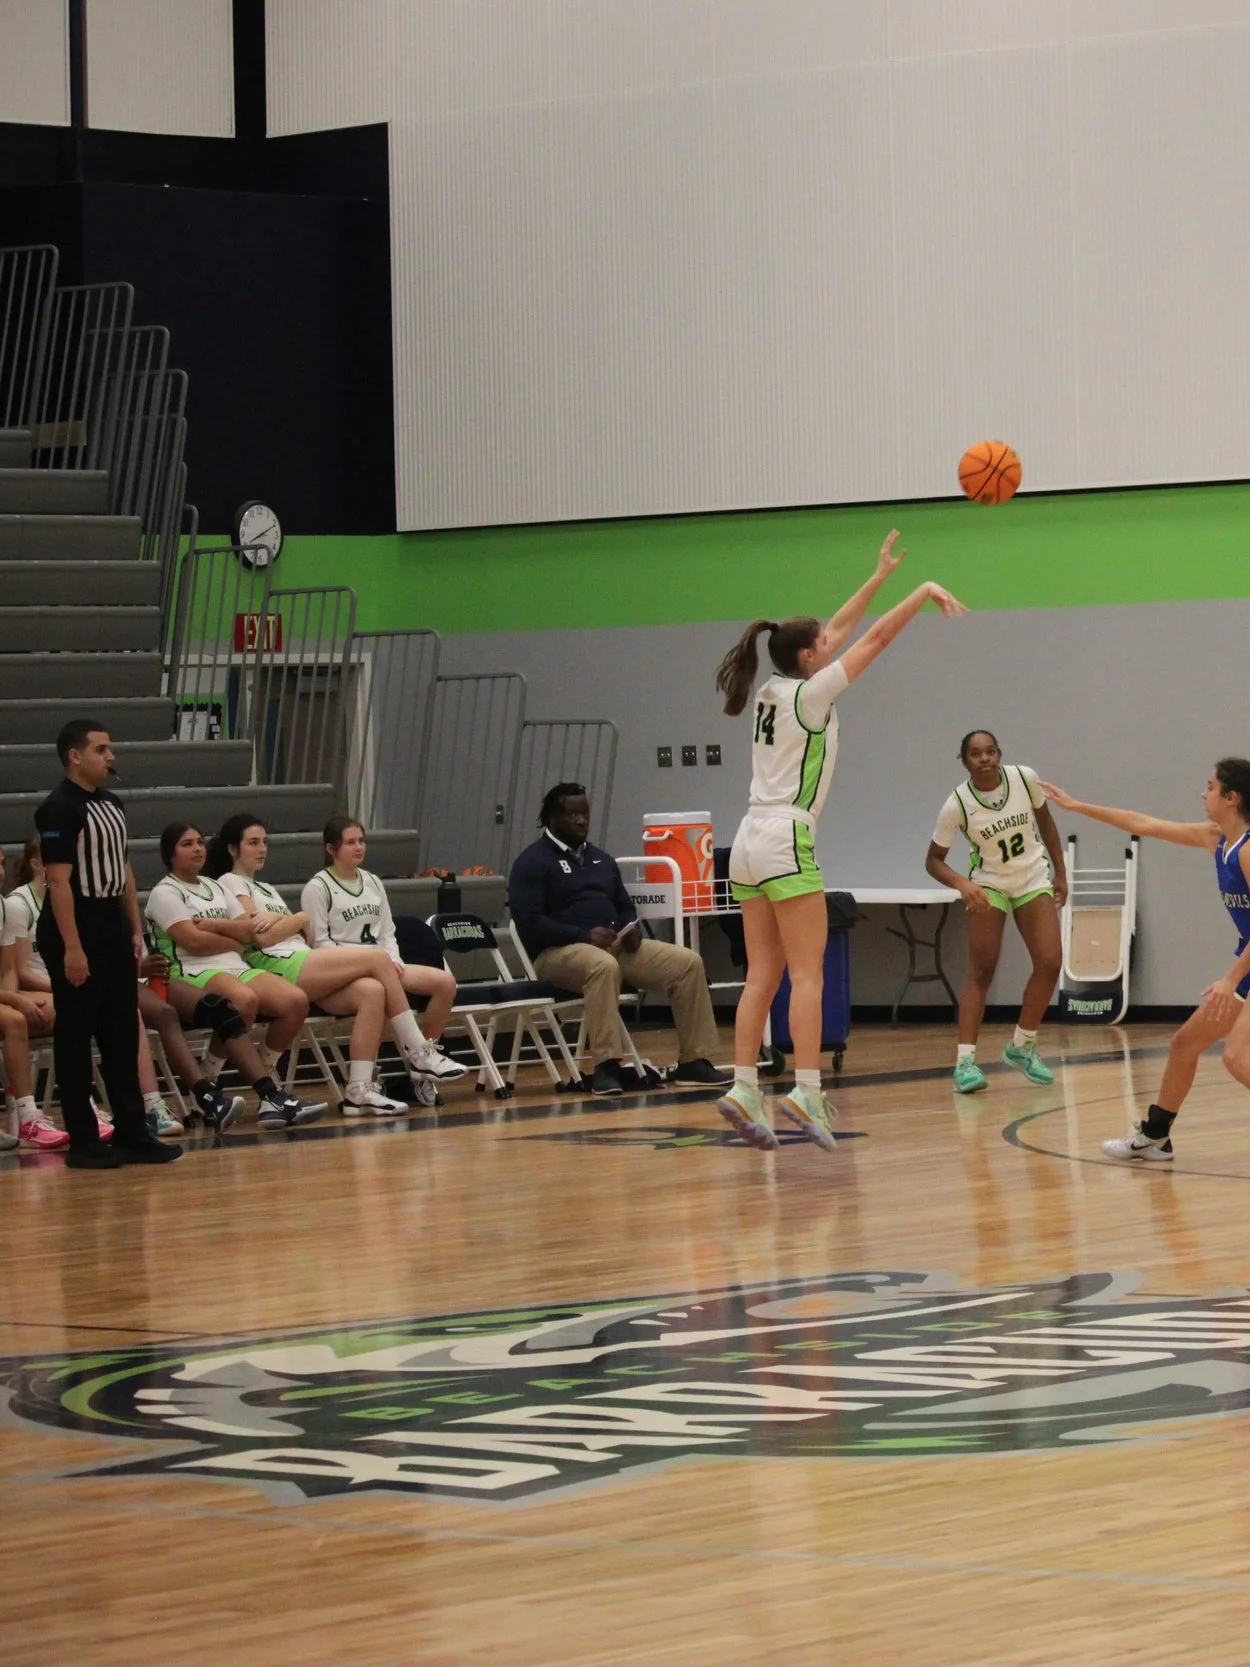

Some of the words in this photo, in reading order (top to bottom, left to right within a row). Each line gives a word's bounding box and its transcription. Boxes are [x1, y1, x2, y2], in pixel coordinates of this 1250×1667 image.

[257, 506, 263, 516] 12
[754, 701, 777, 746] 14
[979, 812, 1030, 841] BEACHSIDE
[997, 832, 1026, 864] 12
[631, 894, 666, 905] TORADE
[341, 903, 381, 922] BEACHSID
[360, 923, 377, 944] 4
[338, 1310, 1094, 1420] BEACHSIDE
